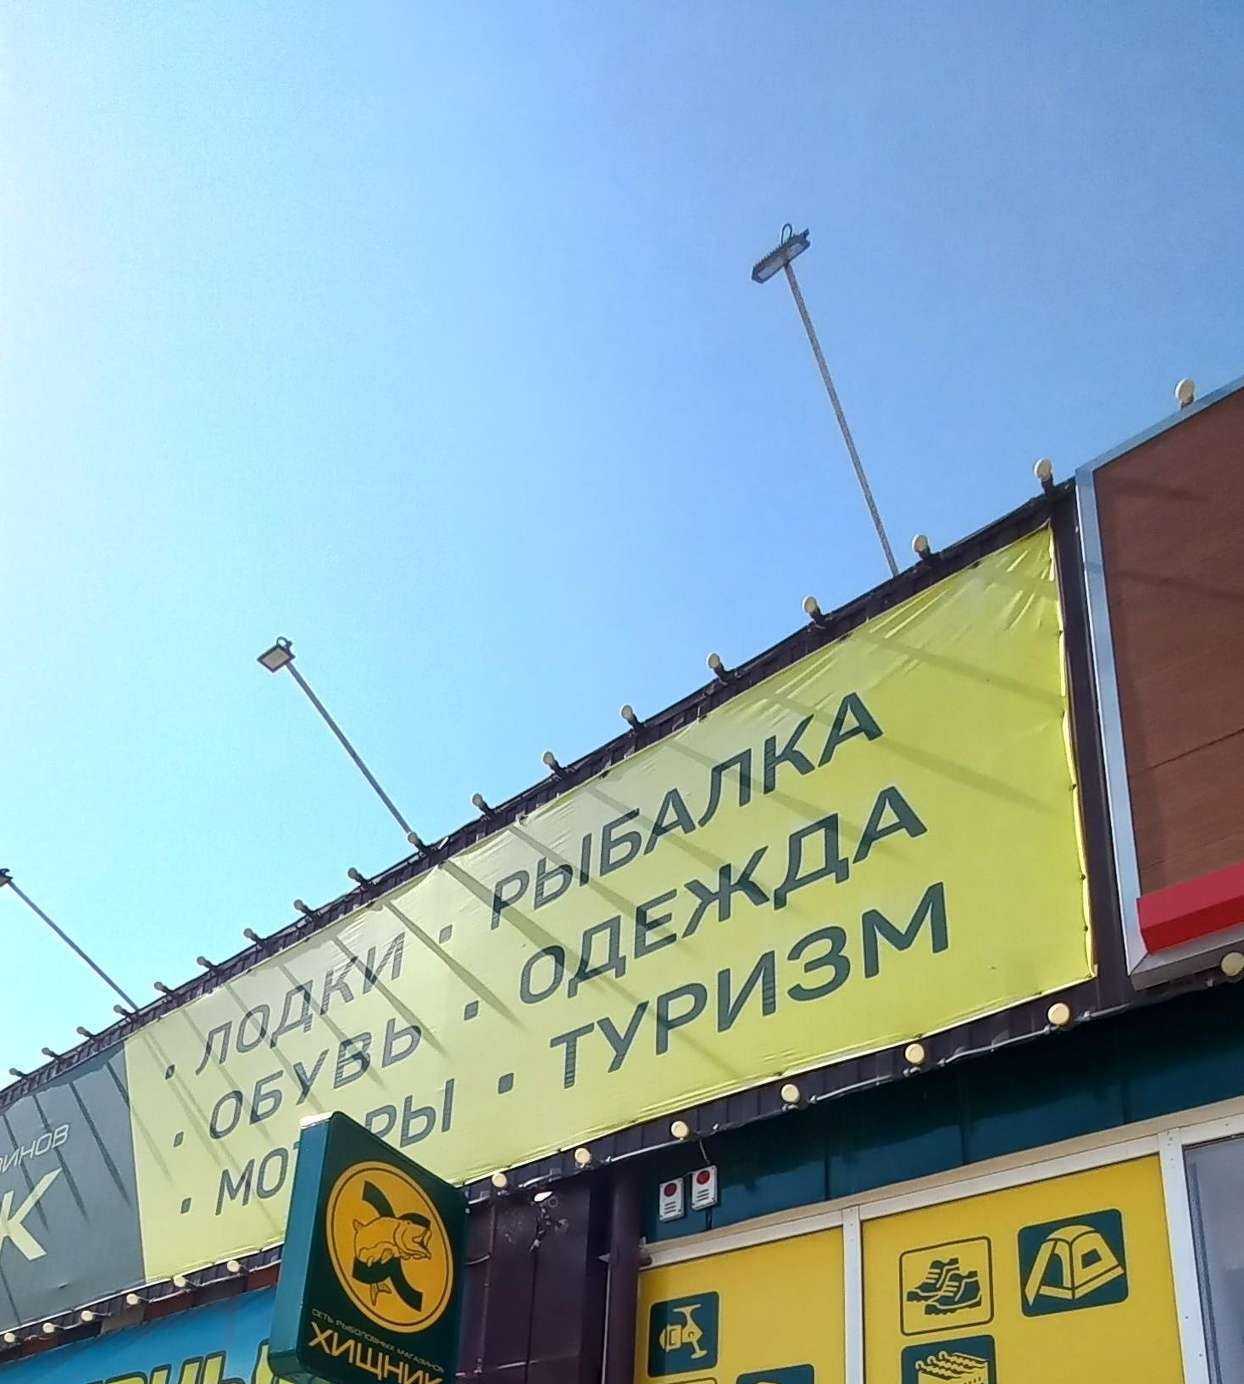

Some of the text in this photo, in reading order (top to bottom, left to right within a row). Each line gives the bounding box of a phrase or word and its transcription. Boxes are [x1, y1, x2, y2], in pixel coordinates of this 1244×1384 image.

[195, 691, 885, 1076] ЛОДКИ РЫБАЛКА
[208, 785, 928, 1140] ОБУВЬ ОДЕЖДА
[214, 881, 949, 1216] МОРЫ ТУРИЗМ
[0, 1124, 70, 1173] ИНОВ
